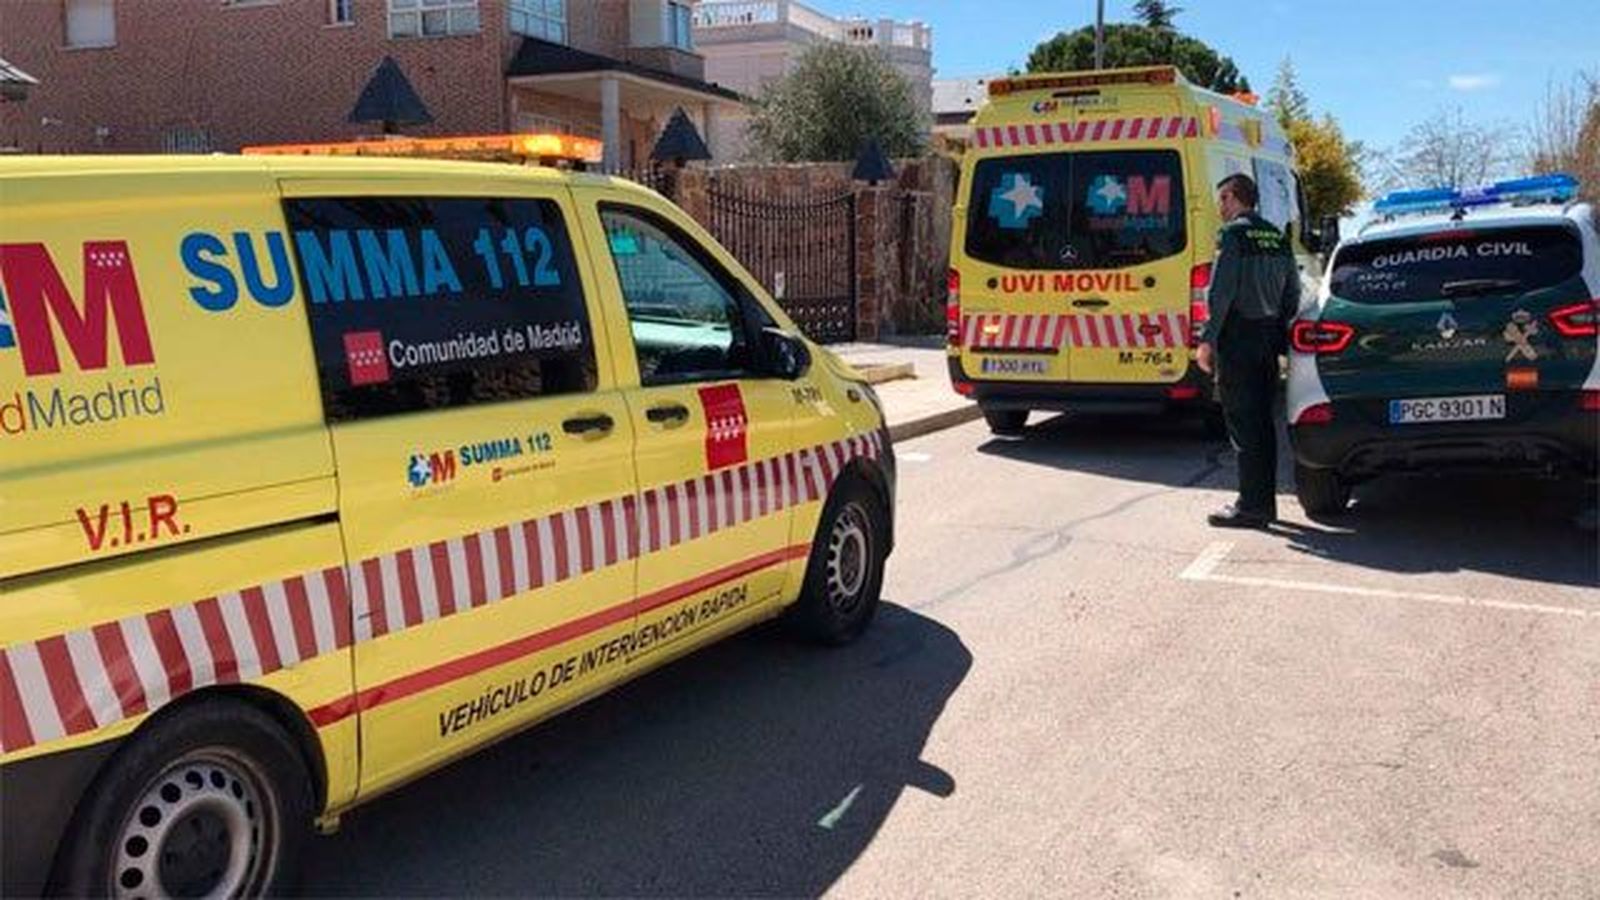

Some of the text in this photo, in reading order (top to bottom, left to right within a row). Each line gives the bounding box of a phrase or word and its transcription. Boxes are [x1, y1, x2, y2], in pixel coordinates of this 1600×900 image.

[1126, 175, 1170, 214] M
[180, 226, 561, 313] SUMMA 112
[1372, 242, 1533, 269] GUARDIA CIVIL
[1001, 273, 1044, 293] UVI
[388, 321, 582, 368] Comunidad de Madrid
[1119, 351, 1173, 365] M-764
[1401, 400, 1502, 420] PGC 9301 N
[459, 432, 552, 467] SUMMA 112
[75, 494, 191, 551] V.I.R.
[438, 670, 546, 737] VEHÍCULO
[549, 660, 580, 690] DE
[579, 604, 698, 678] INTERVENCIÓN
